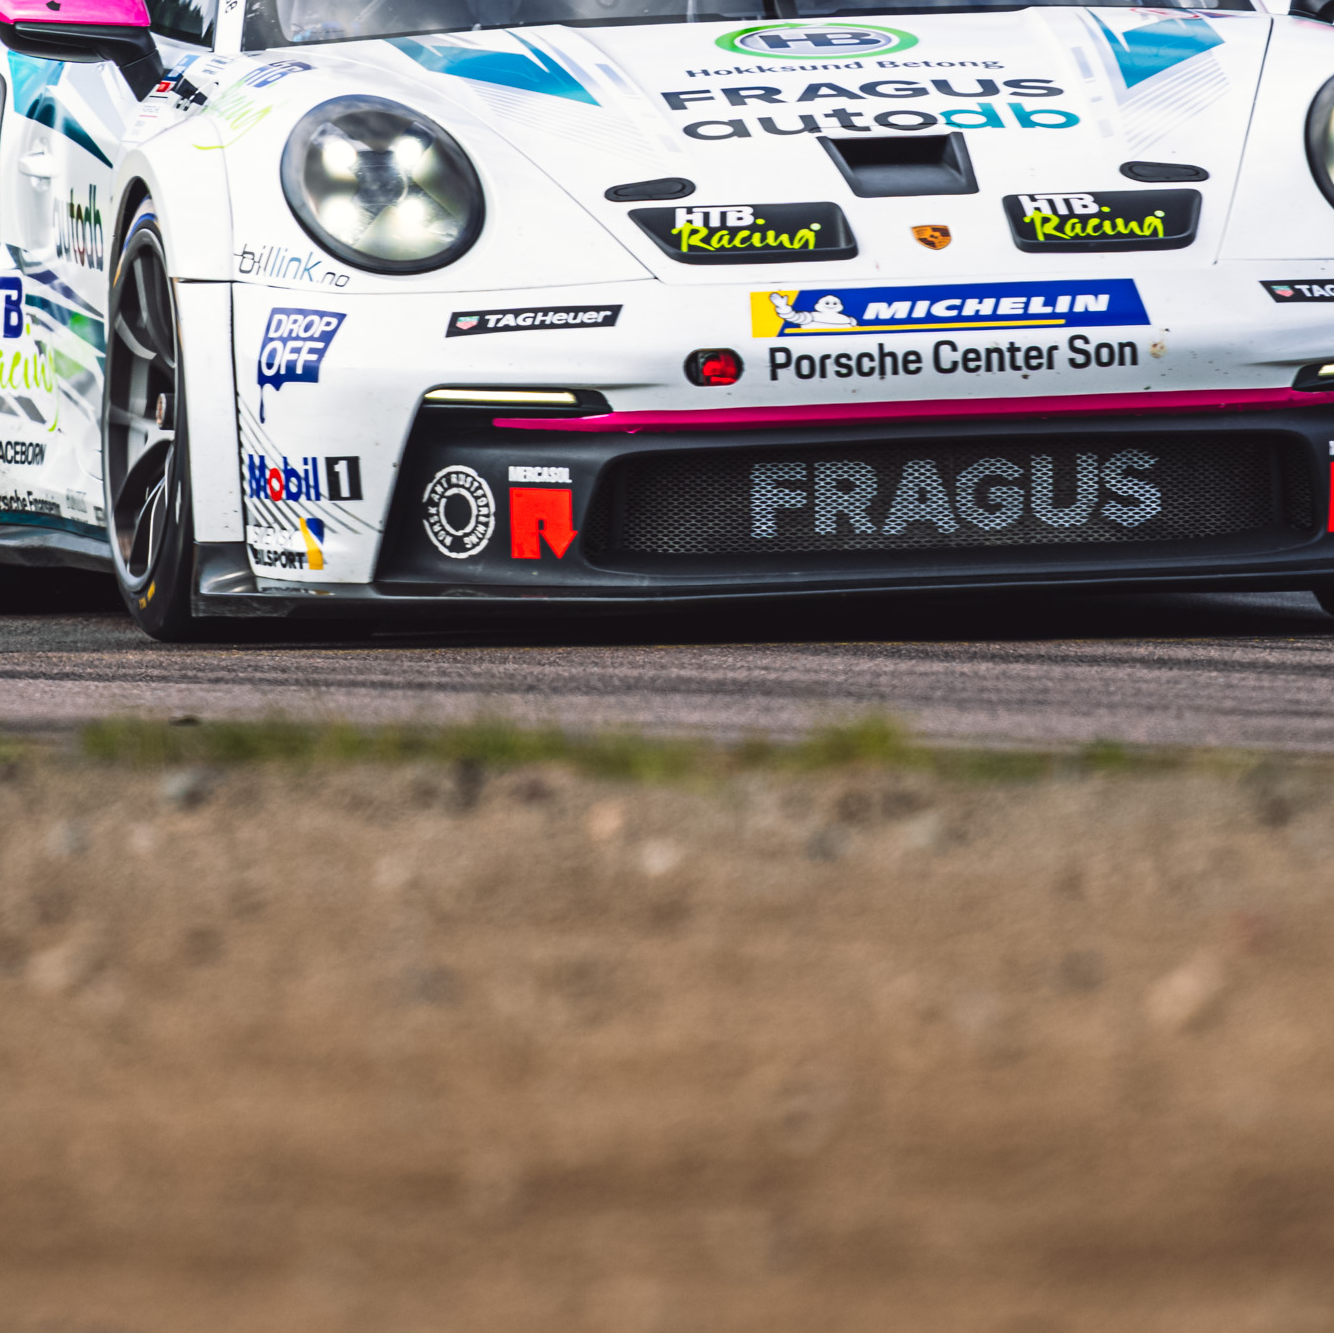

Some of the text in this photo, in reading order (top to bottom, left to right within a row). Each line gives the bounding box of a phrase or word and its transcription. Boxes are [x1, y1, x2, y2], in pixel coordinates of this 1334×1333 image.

[686, 59, 1006, 78] Hokksund Betong
[661, 78, 1064, 112] FRAGUS
[683, 102, 1081, 142] autodb
[675, 206, 755, 228] HTB
[1018, 193, 1100, 217] HTB
[671, 219, 818, 252] Racing
[1023, 206, 1165, 241] Racing
[234, 243, 352, 288] billink.no
[863, 294, 1110, 320] MICHELIN
[268, 313, 338, 338] DROP
[261, 340, 326, 376] OFF
[769, 333, 1139, 381] Porsche Center Son
[247, 454, 321, 502] Mobil
[750, 449, 1163, 539] FRAGUS
